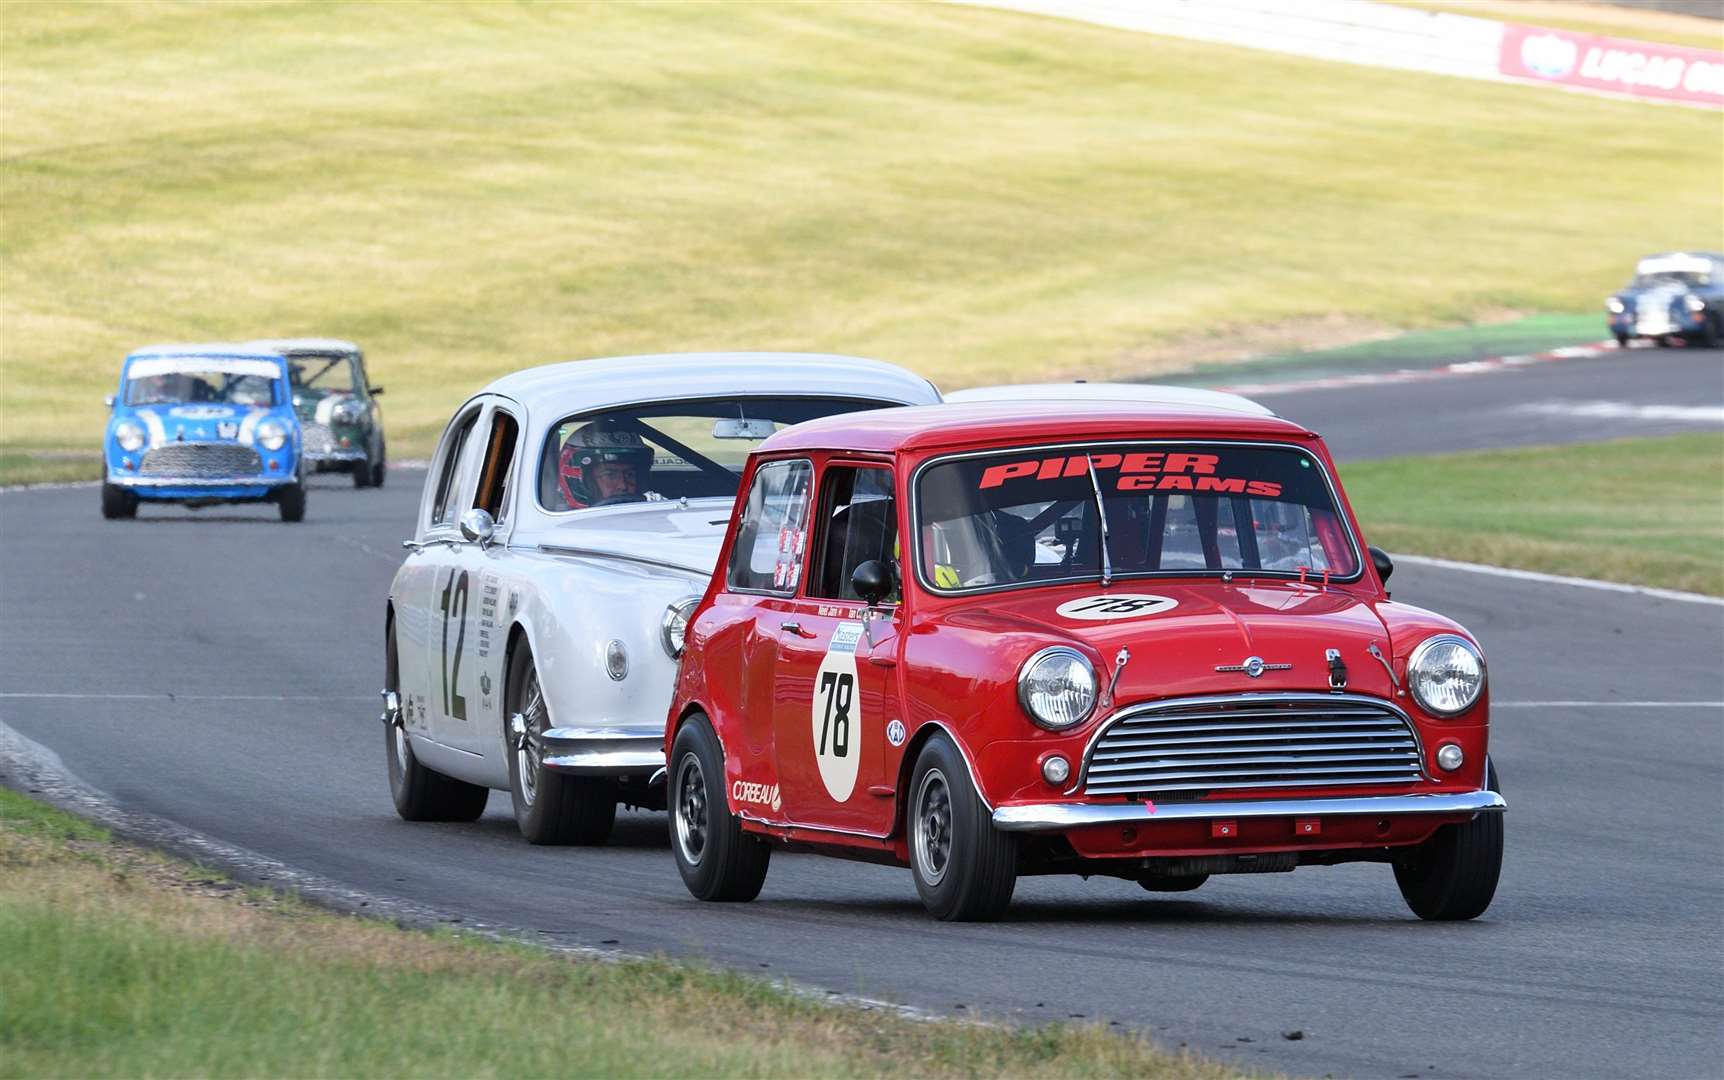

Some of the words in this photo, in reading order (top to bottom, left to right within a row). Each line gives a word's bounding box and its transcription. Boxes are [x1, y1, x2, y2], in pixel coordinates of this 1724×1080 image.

[979, 453, 1219, 489] PIPER
[1117, 475, 1282, 497] CAMS
[1068, 598, 1165, 613] 78
[440, 567, 470, 722] 12
[819, 671, 854, 758] 78
[732, 780, 774, 805] CORBEAU
